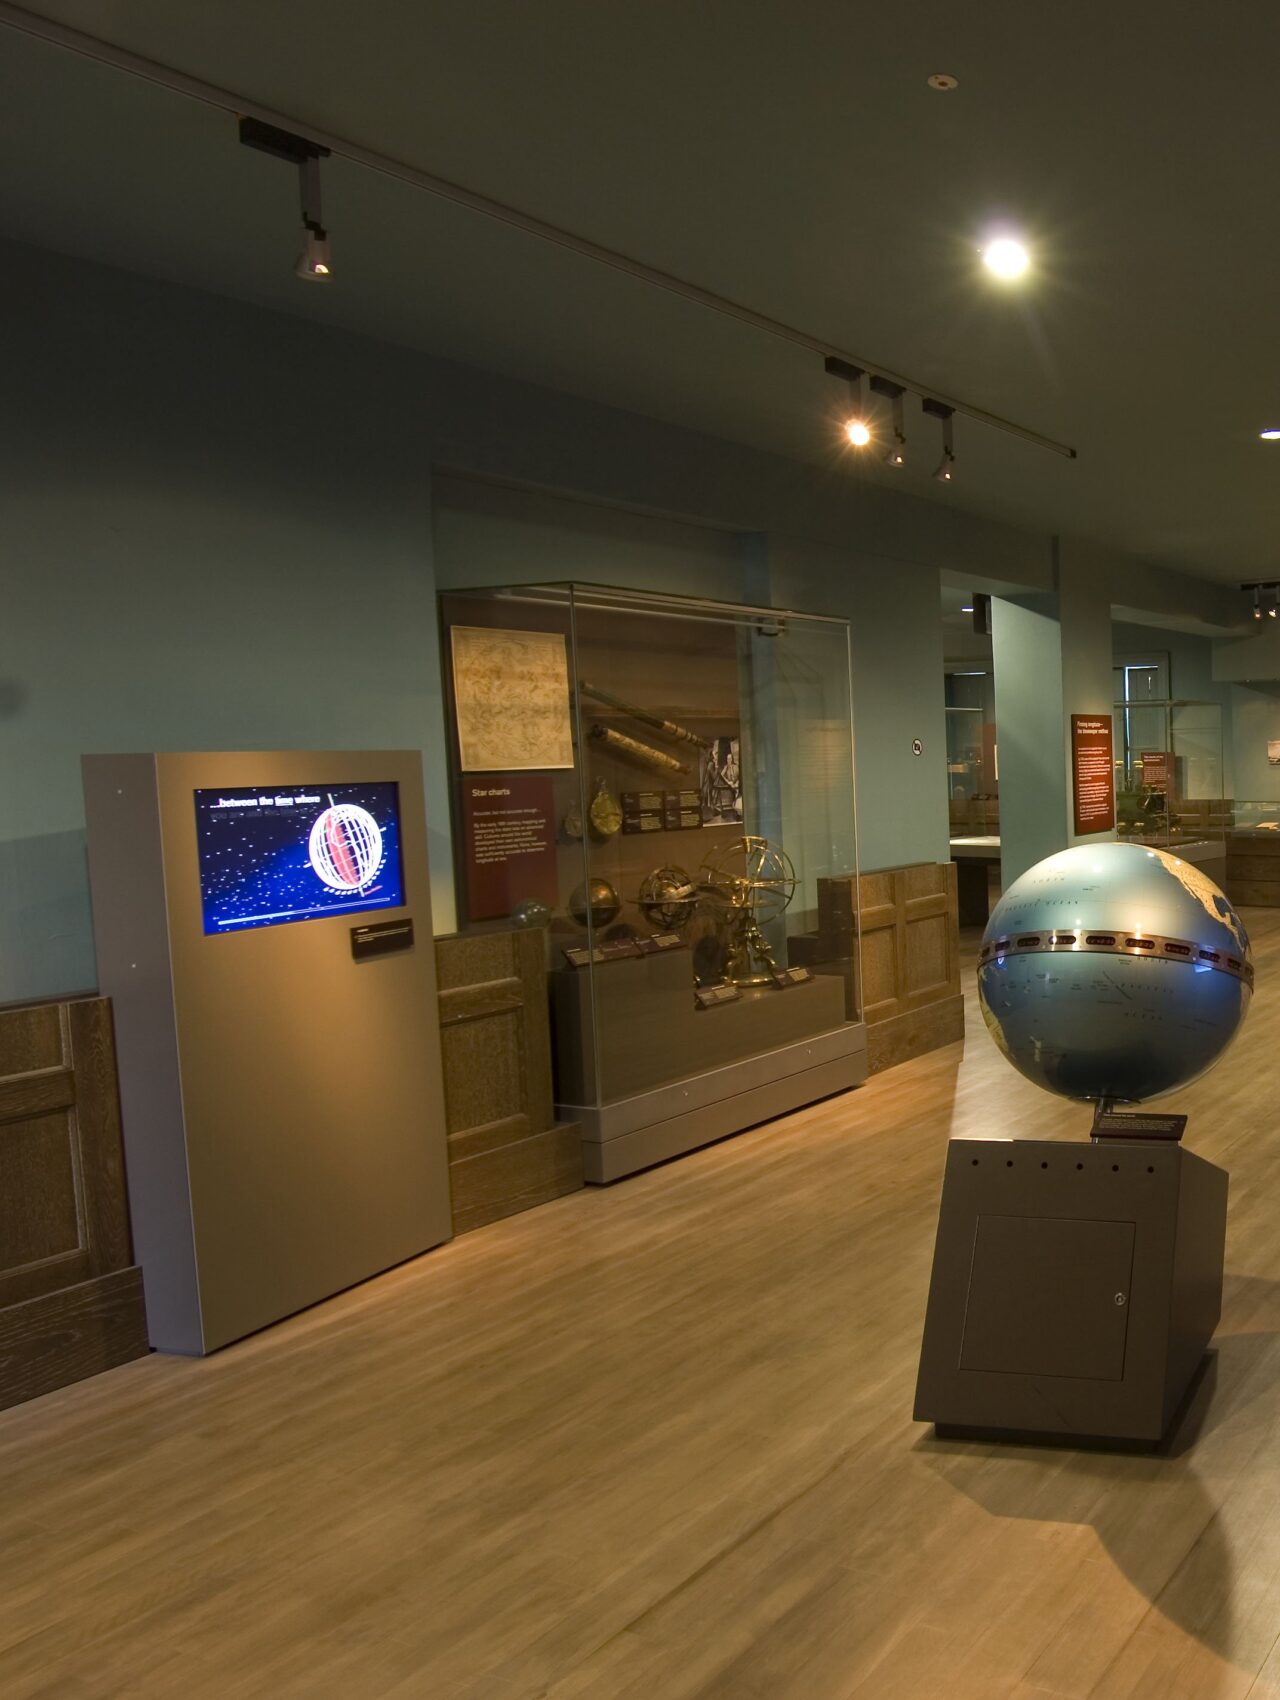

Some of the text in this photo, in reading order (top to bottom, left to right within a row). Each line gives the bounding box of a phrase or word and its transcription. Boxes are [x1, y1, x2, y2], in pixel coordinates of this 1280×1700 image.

[471, 788, 511, 797] Star charts
[259, 796, 274, 806] the
[274, 795, 294, 806] time
[294, 794, 321, 804] where
